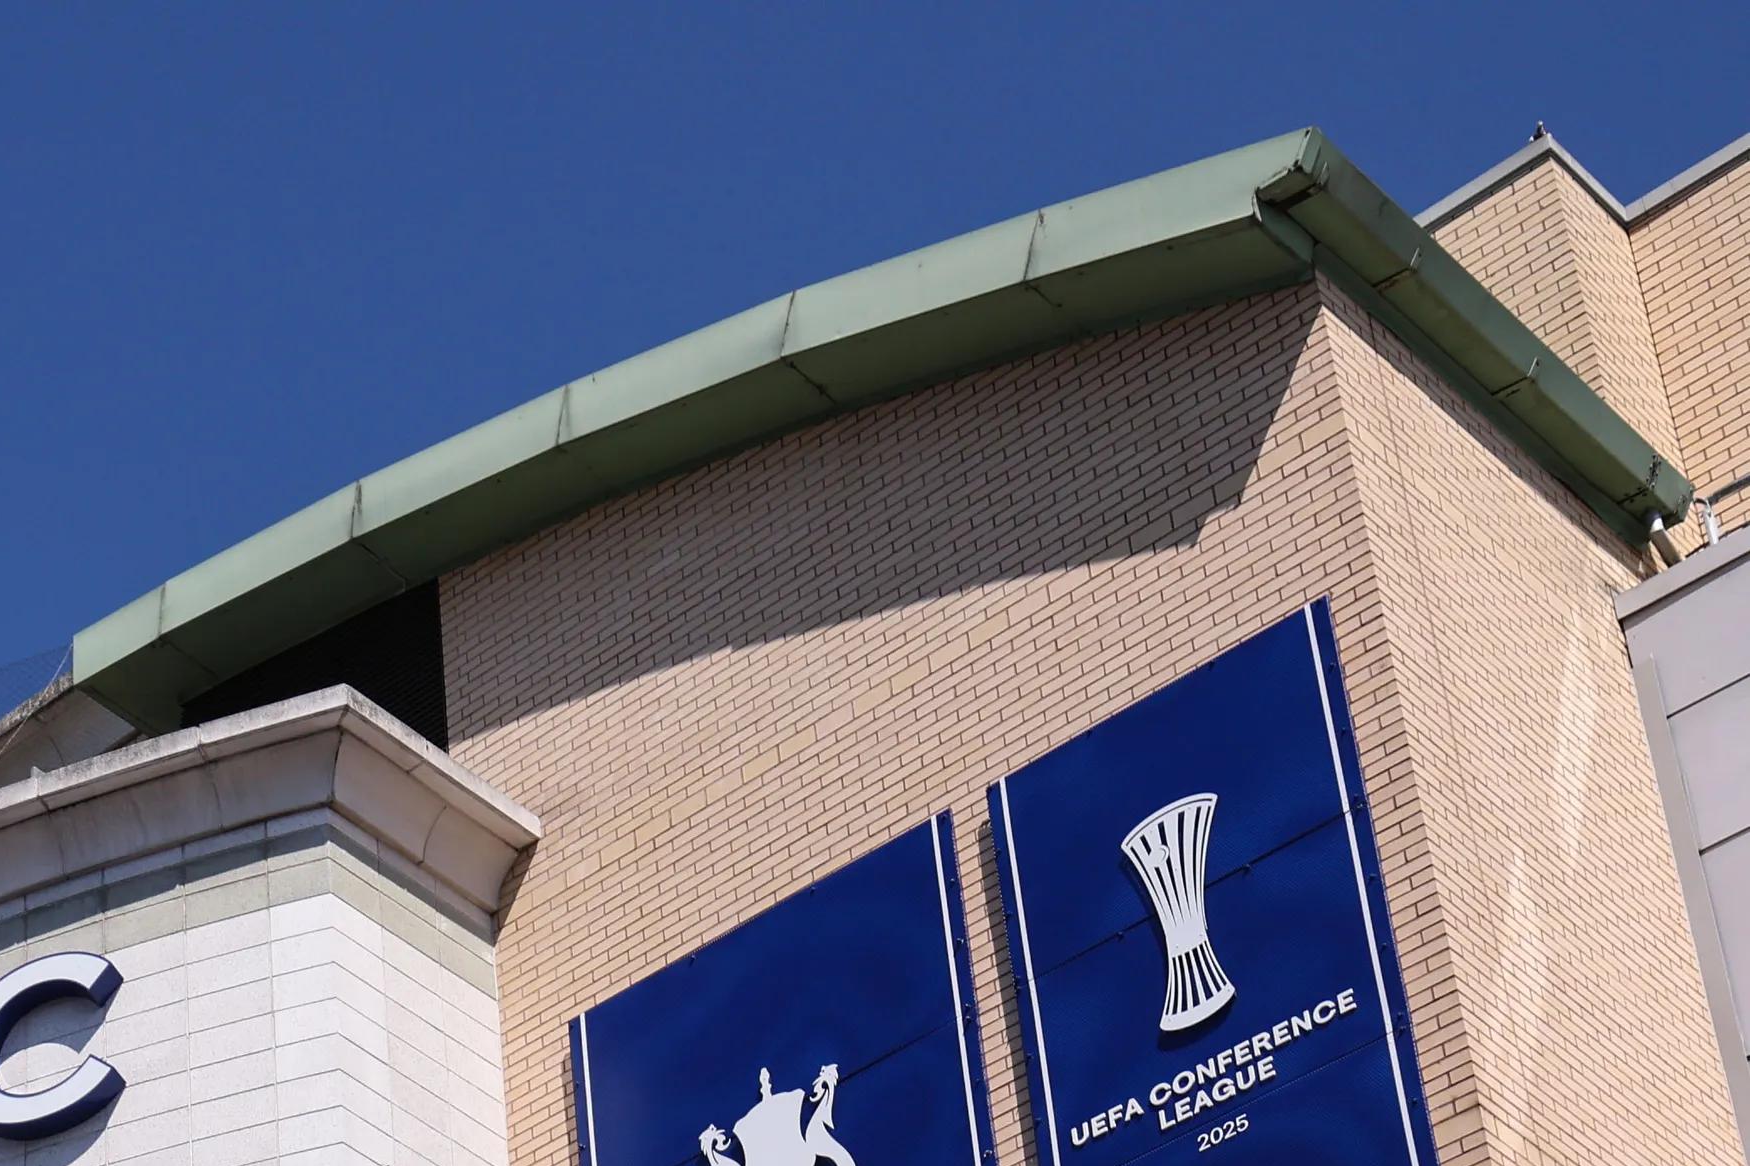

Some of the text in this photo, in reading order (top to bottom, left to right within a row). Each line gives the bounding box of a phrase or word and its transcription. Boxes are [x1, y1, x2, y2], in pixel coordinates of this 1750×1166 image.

[1070, 988, 1358, 1147] UEFA CONFERENCE
[1158, 1055, 1277, 1131] LEAGUE
[1197, 1113, 1249, 1152] 2025
